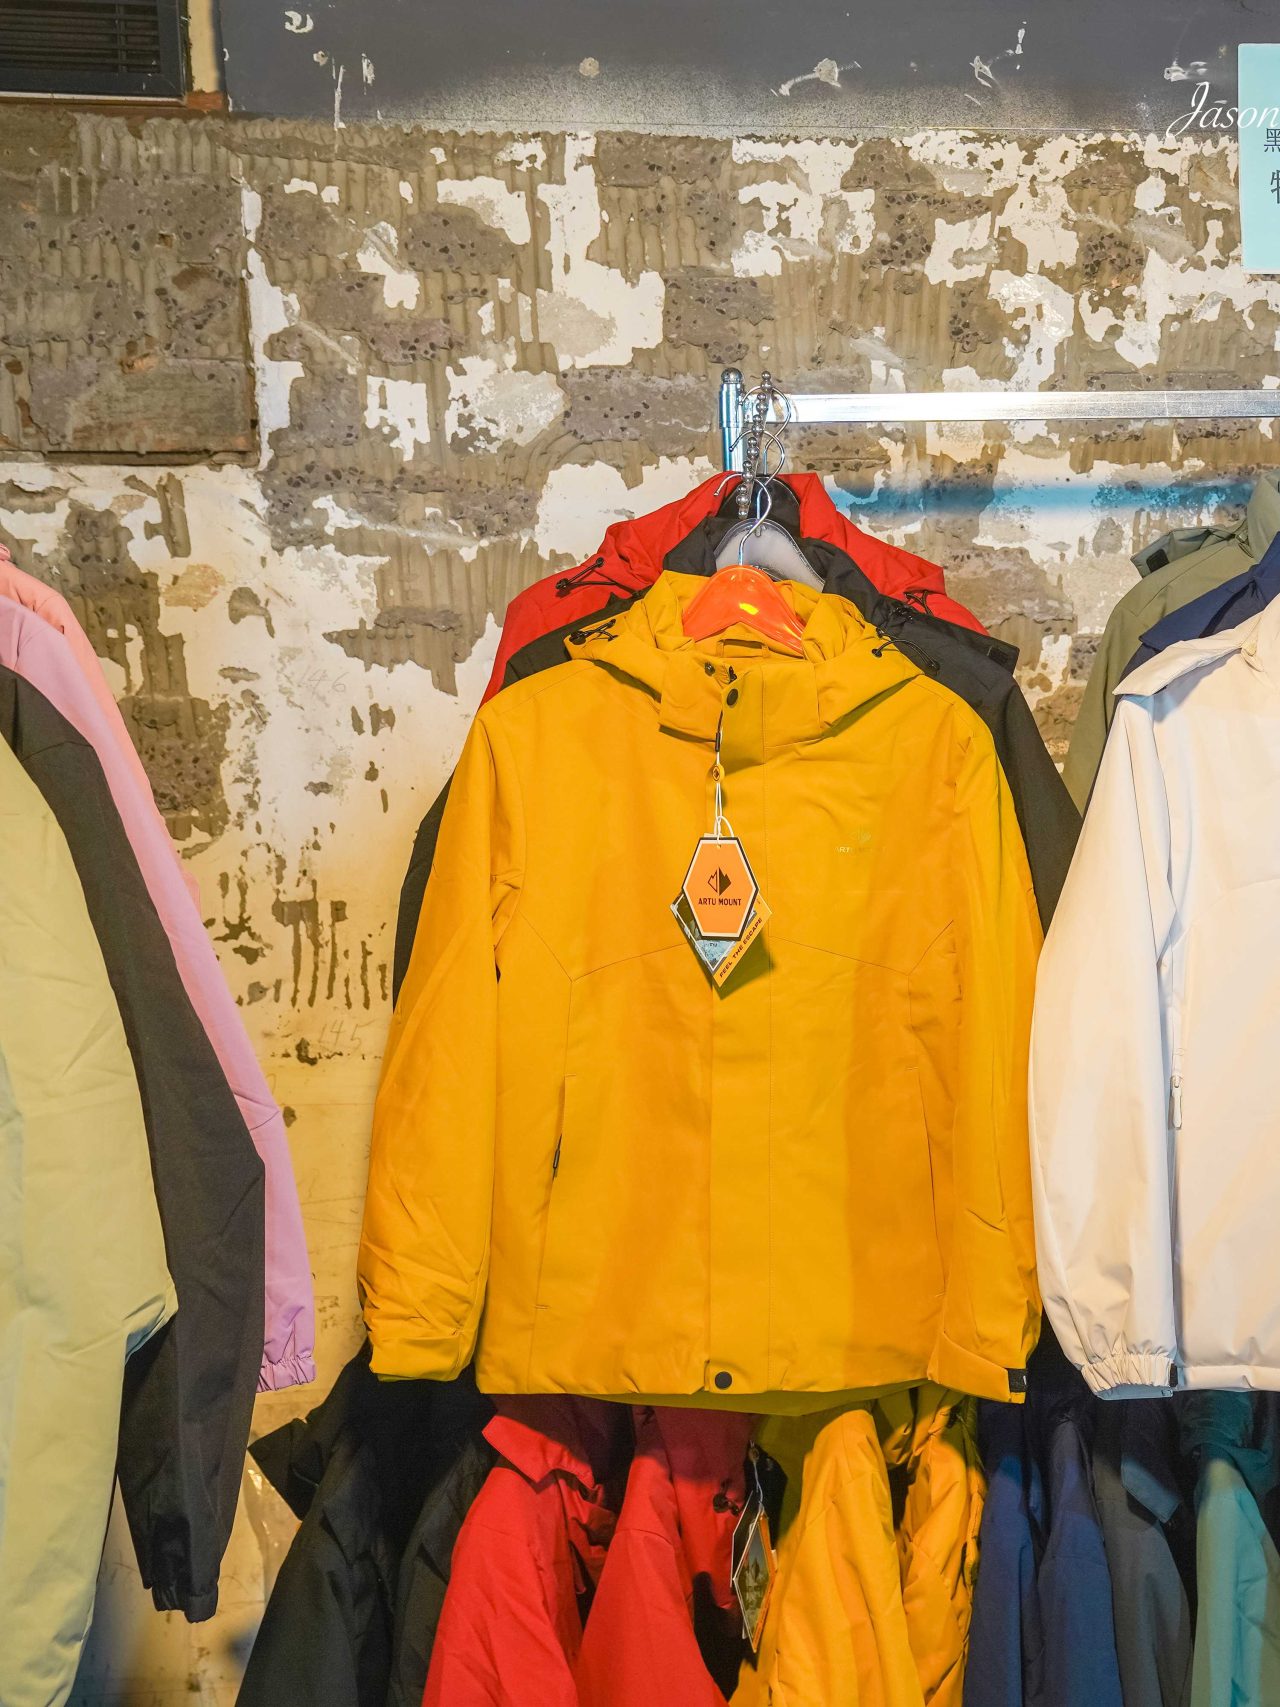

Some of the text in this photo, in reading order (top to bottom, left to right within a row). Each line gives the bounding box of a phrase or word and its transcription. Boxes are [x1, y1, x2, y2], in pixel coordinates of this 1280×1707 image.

[698, 897, 742, 907] ARTU MOUNT
[732, 944, 744, 959] THE
